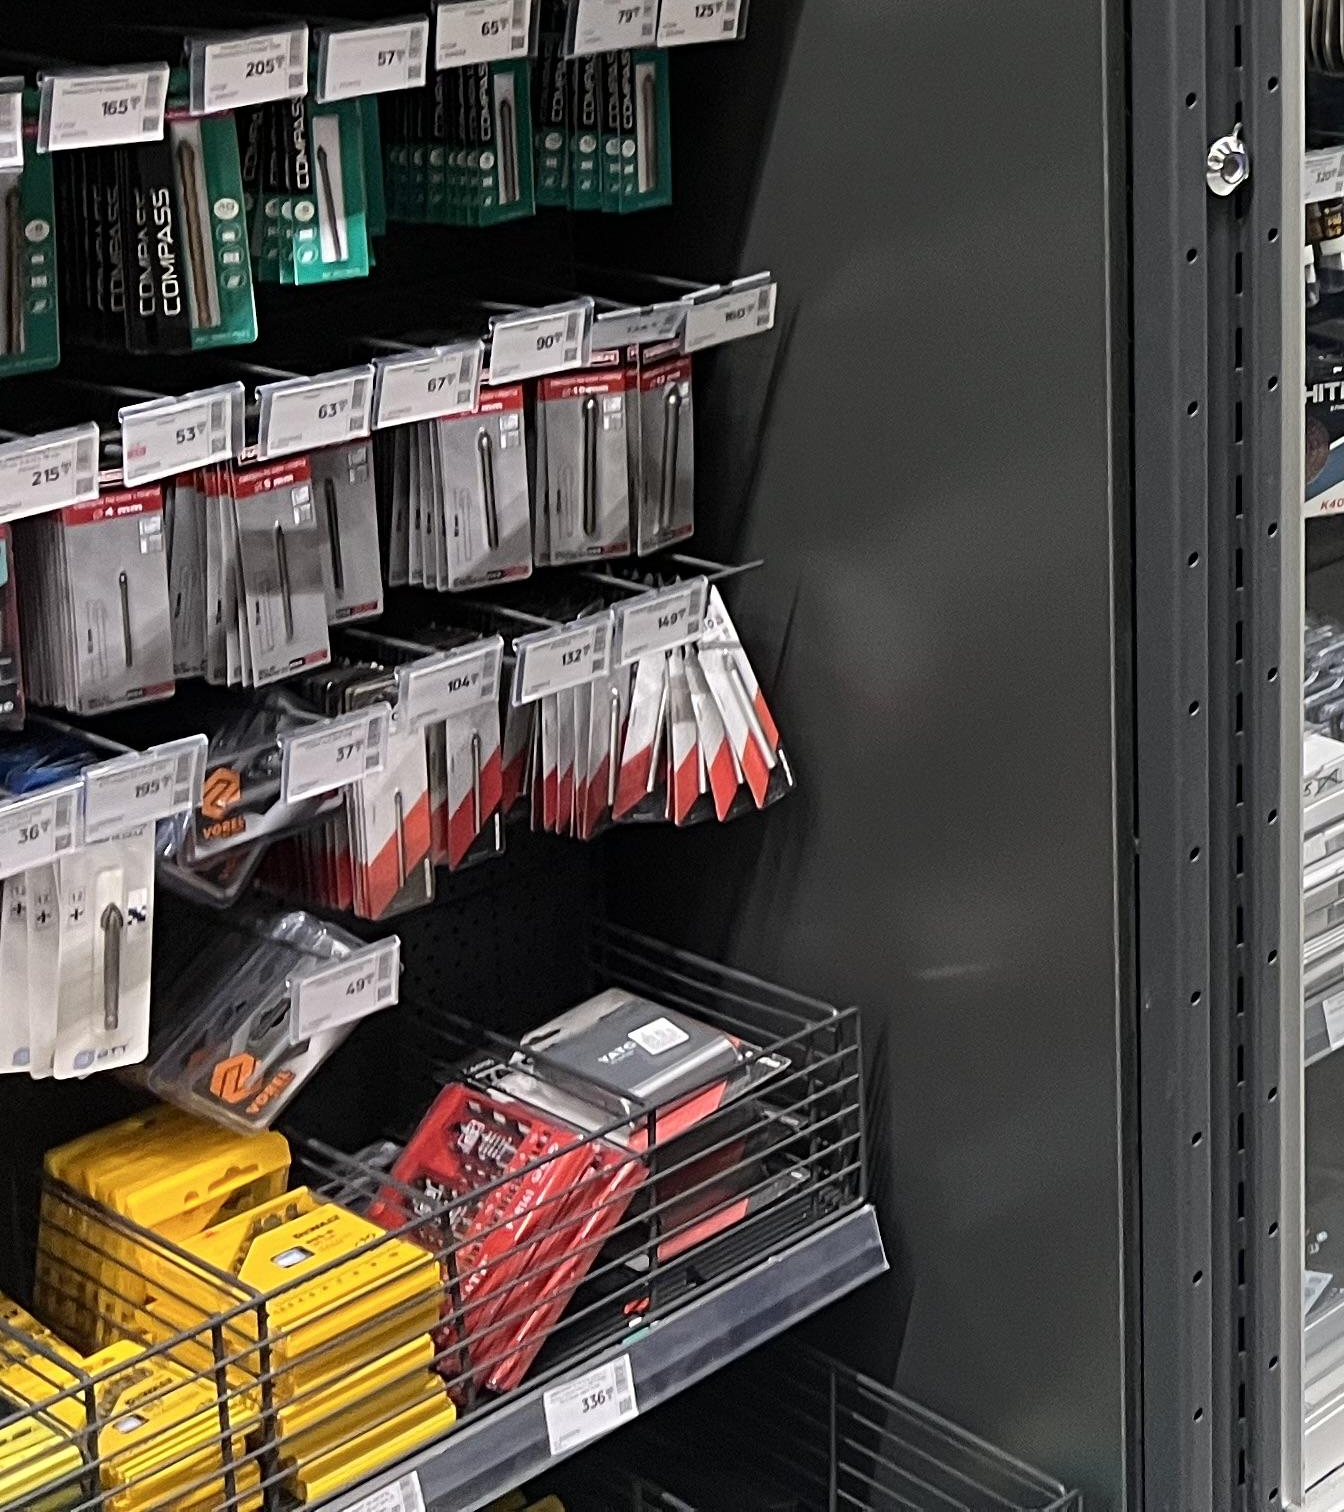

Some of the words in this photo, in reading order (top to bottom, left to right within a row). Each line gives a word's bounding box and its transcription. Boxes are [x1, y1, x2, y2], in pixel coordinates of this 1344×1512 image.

[617, 9, 634, 24] 79
[377, 50, 395, 67] 57
[245, 59, 275, 78] 205
[101, 97, 129, 117] 165
[150, 188, 182, 317] COMPASS
[536, 336, 554, 351] 90
[176, 427, 196, 446] 53
[32, 468, 60, 487] 215
[581, 1390, 607, 1414] 336
